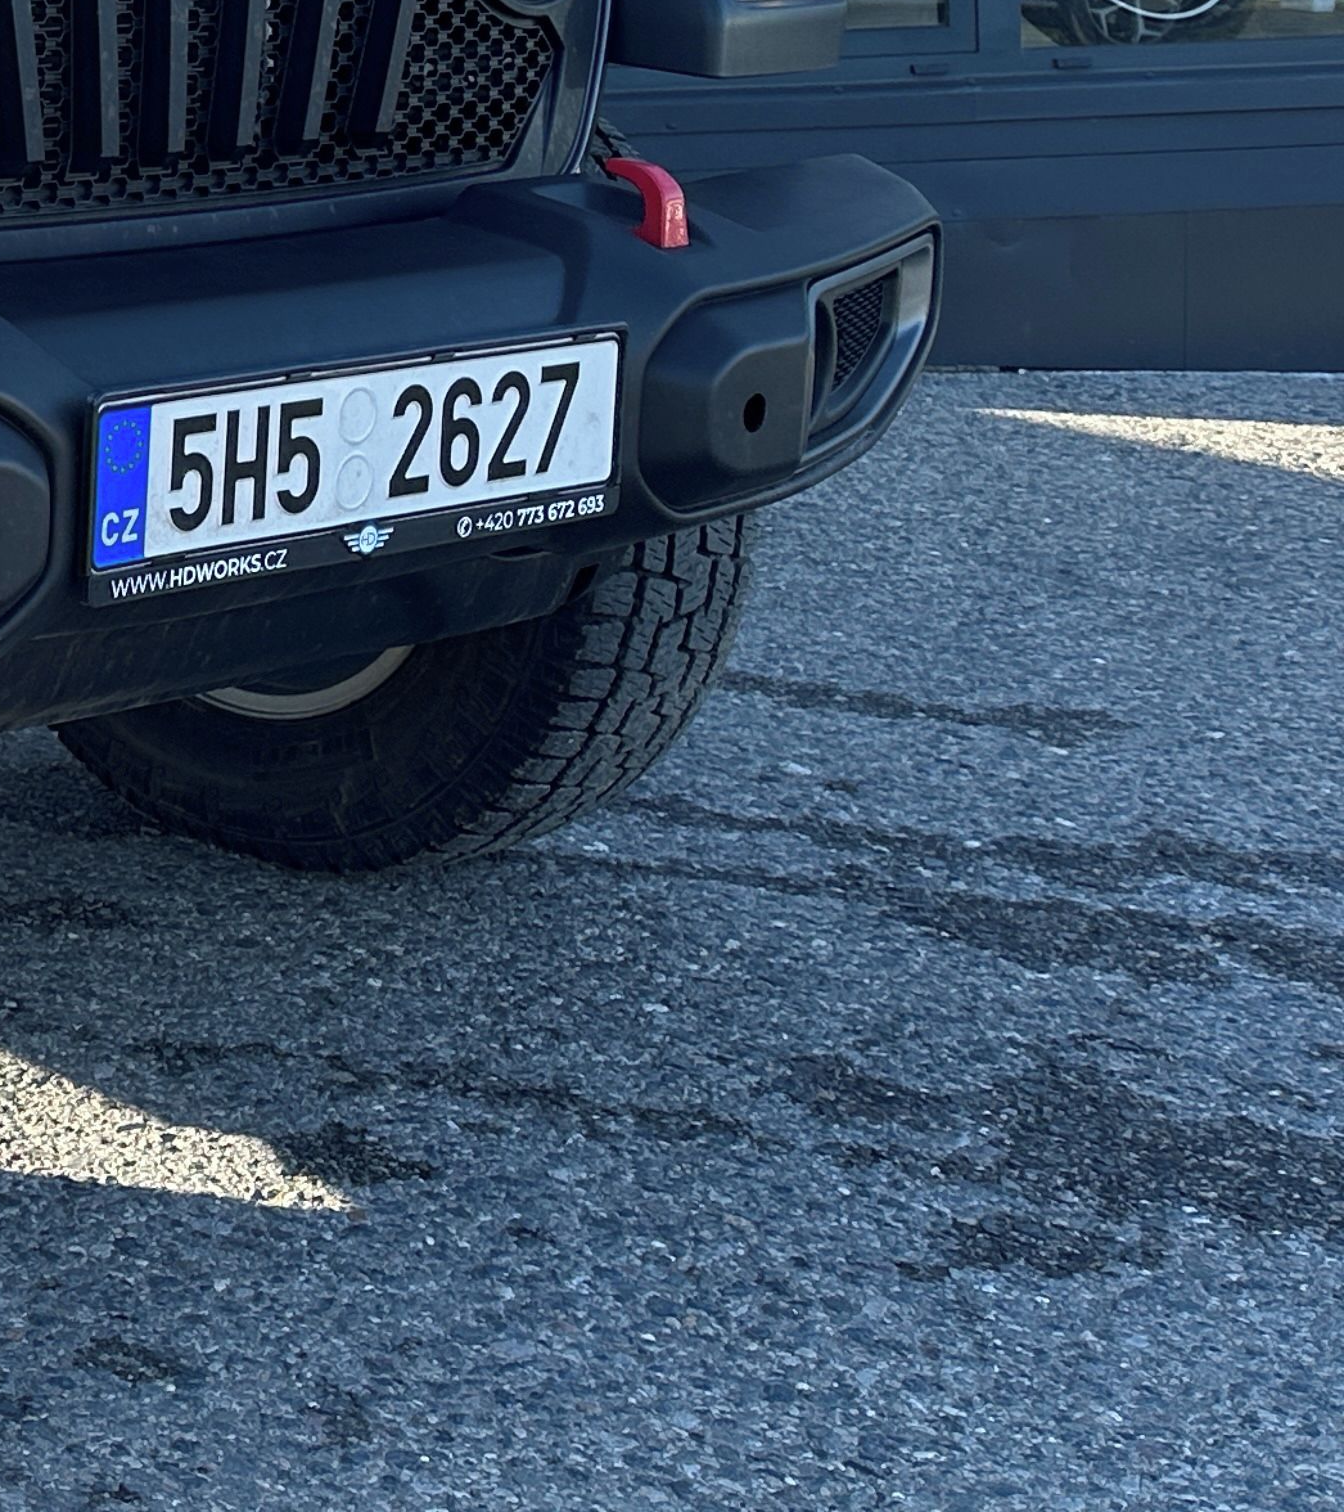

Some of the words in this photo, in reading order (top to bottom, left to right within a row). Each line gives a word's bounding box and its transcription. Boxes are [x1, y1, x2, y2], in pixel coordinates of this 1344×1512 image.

[168, 398, 324, 532] 5H5
[388, 362, 580, 498] 2627
[101, 507, 139, 547] CZ
[475, 511, 514, 531] +420
[517, 504, 545, 527] 773
[547, 500, 575, 522] 672
[577, 494, 605, 515] 693
[111, 549, 288, 598] WWW.HDWORKS.CZ
